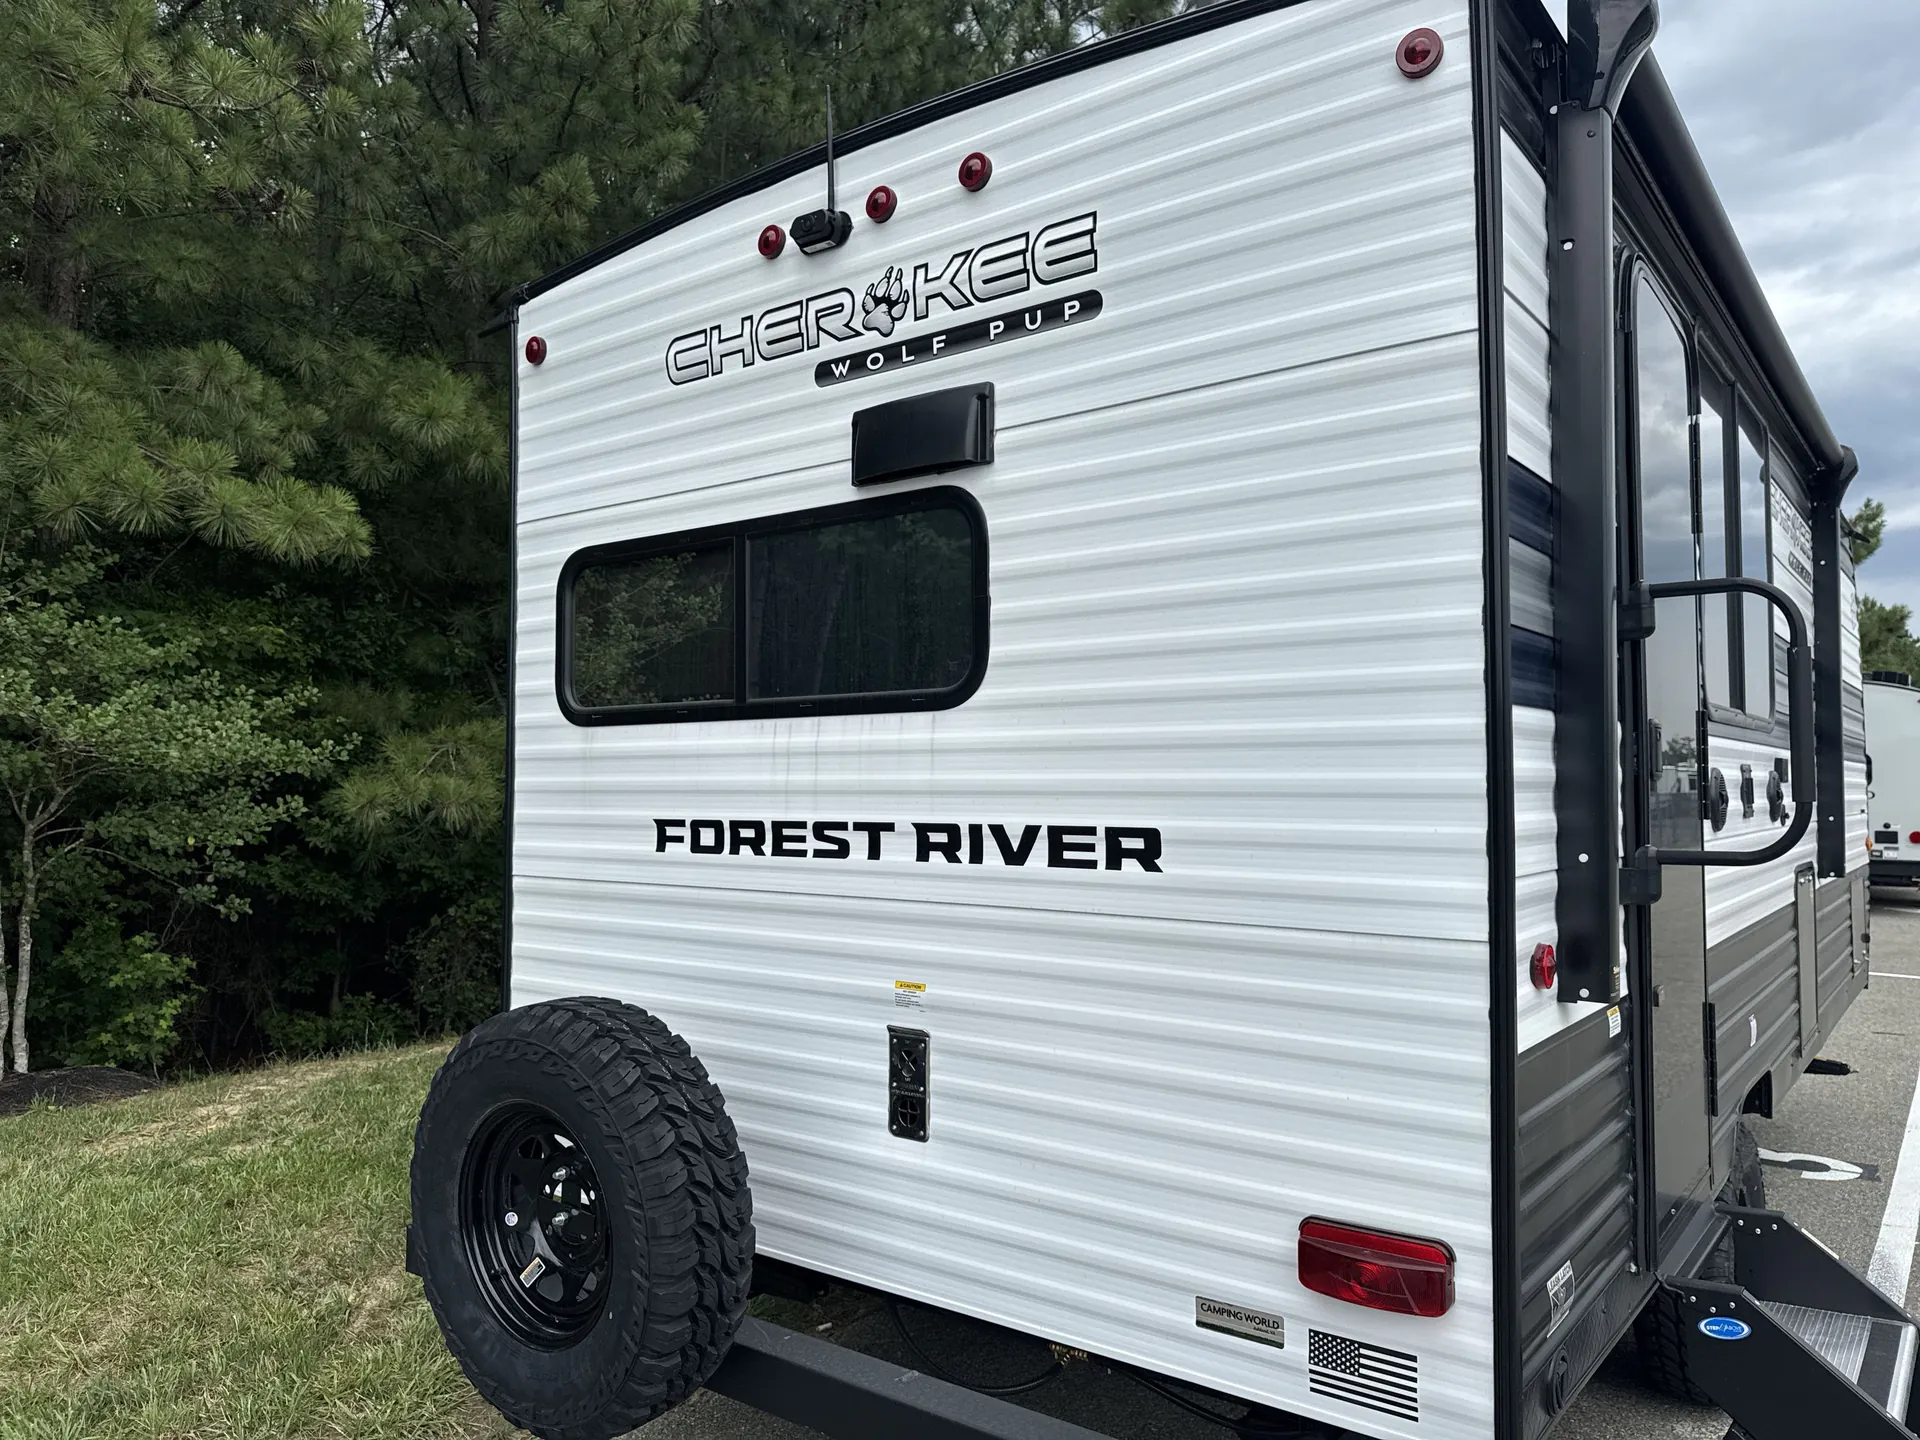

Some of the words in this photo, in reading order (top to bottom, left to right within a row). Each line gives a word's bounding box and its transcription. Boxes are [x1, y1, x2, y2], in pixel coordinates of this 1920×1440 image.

[830, 335, 947, 379] WOLF
[988, 300, 1081, 341] PUP
[652, 818, 895, 860] FOREST
[911, 822, 1164, 873] RIVER
[1200, 1302, 1243, 1321] CAMPING
[1244, 1313, 1280, 1330] WORLD
